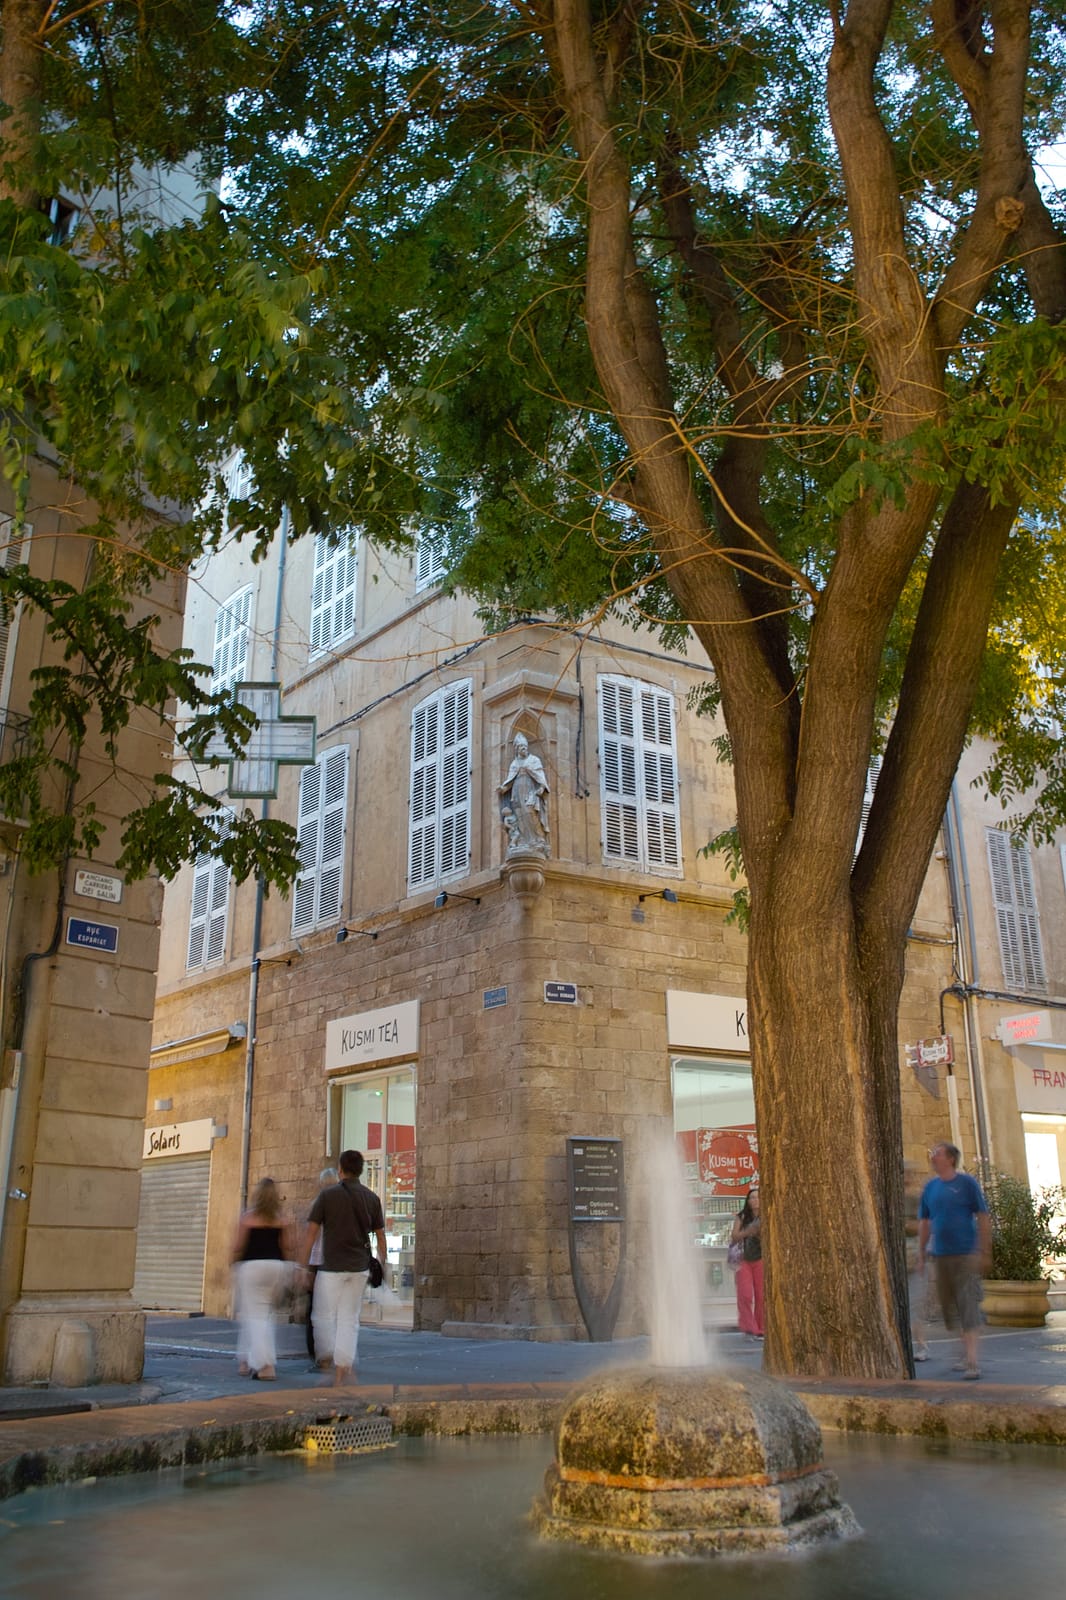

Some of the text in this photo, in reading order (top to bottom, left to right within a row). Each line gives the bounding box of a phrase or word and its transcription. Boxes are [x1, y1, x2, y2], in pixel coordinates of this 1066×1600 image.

[86, 926, 101, 935] RUE
[341, 1018, 399, 1056] KUSMI TEA
[148, 1125, 180, 1155] Solaris
[708, 1153, 755, 1170] KUSMI TEA
